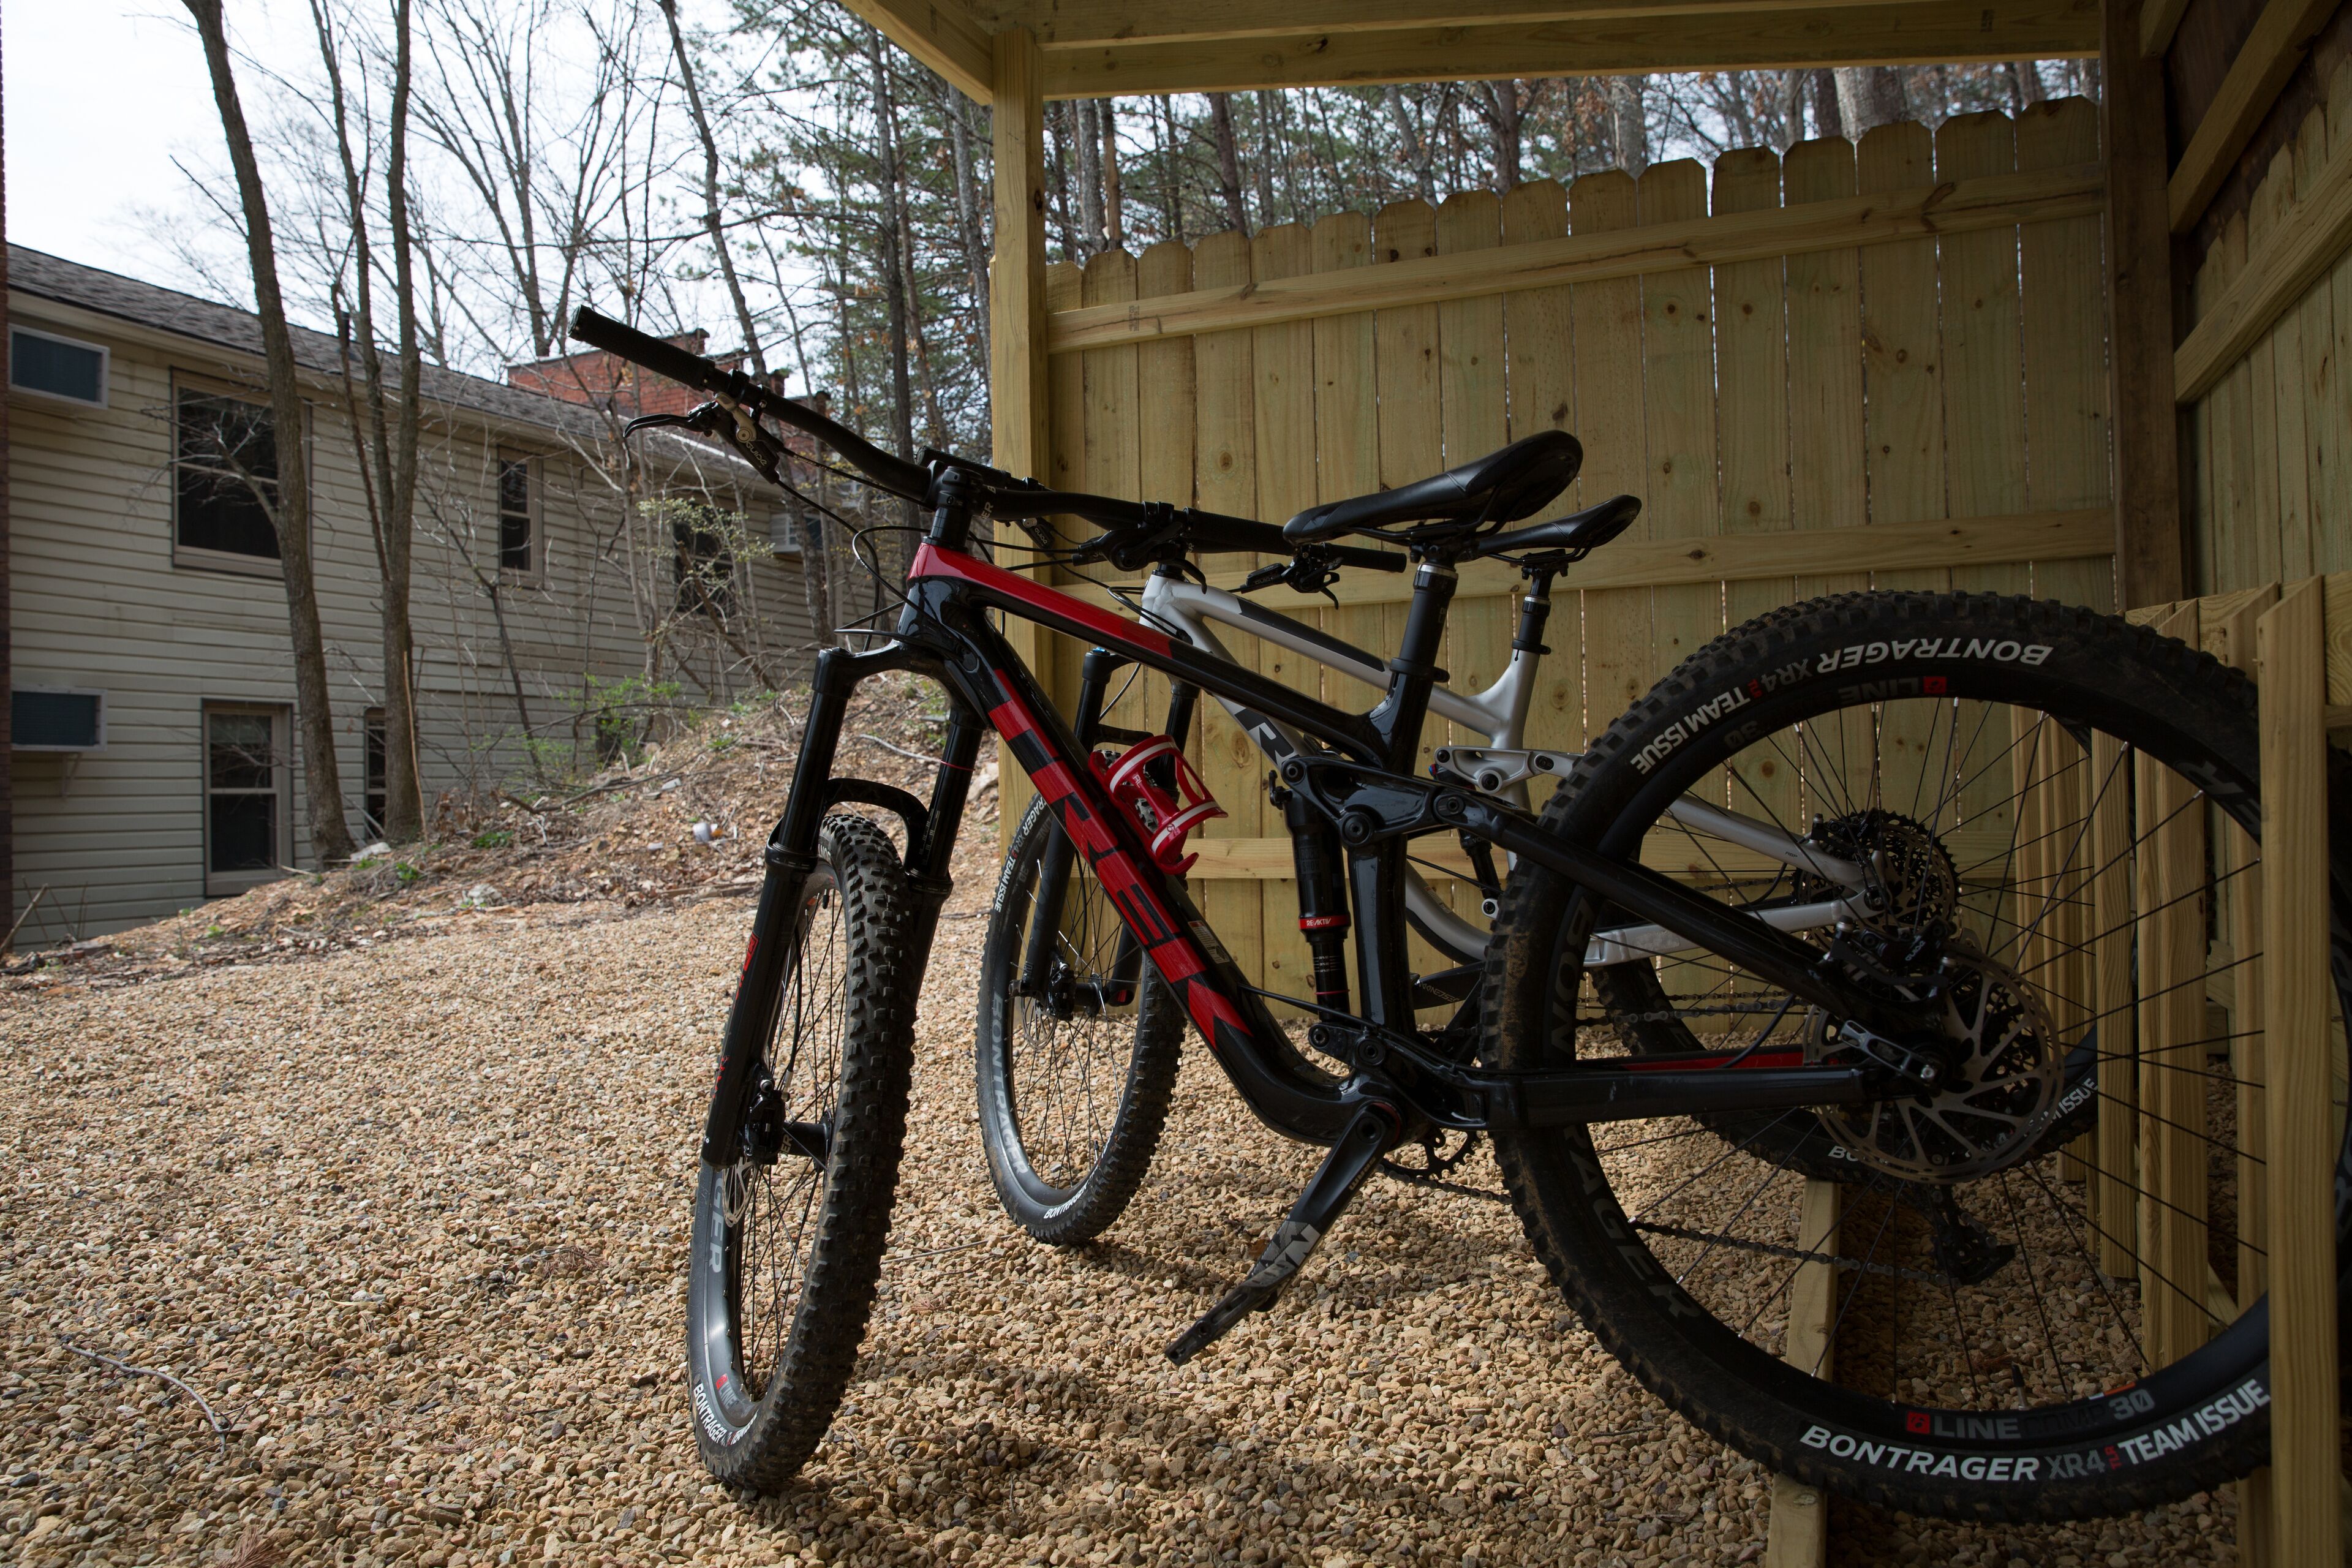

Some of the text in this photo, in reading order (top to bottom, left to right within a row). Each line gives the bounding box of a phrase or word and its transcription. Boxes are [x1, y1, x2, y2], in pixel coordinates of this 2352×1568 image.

[1762, 658, 1808, 694] XR4
[1817, 638, 2053, 674] BONTRAGER
[1838, 677, 1920, 696] LINE
[1684, 687, 1751, 737] TEAM
[1630, 723, 1689, 775] ISSUE
[1023, 796, 1047, 836] TRAGER
[1002, 856, 1018, 884] TEAM
[994, 883, 1008, 913] ISSUE
[992, 990, 1030, 1175] BONTRAGER
[2059, 1078, 2098, 1115] ISSUE
[1551, 894, 1703, 1320] BONRAGER
[693, 1383, 727, 1444] BONTRAGER
[1800, 1423, 2039, 1482] BONTRAGER
[2045, 1449, 2106, 1481] XR4
[2117, 1418, 2204, 1465] TEAM
[2193, 1378, 2271, 1433] ISSUE
[1933, 1417, 2021, 1440] LINE
[2108, 1389, 2155, 1420] 30
